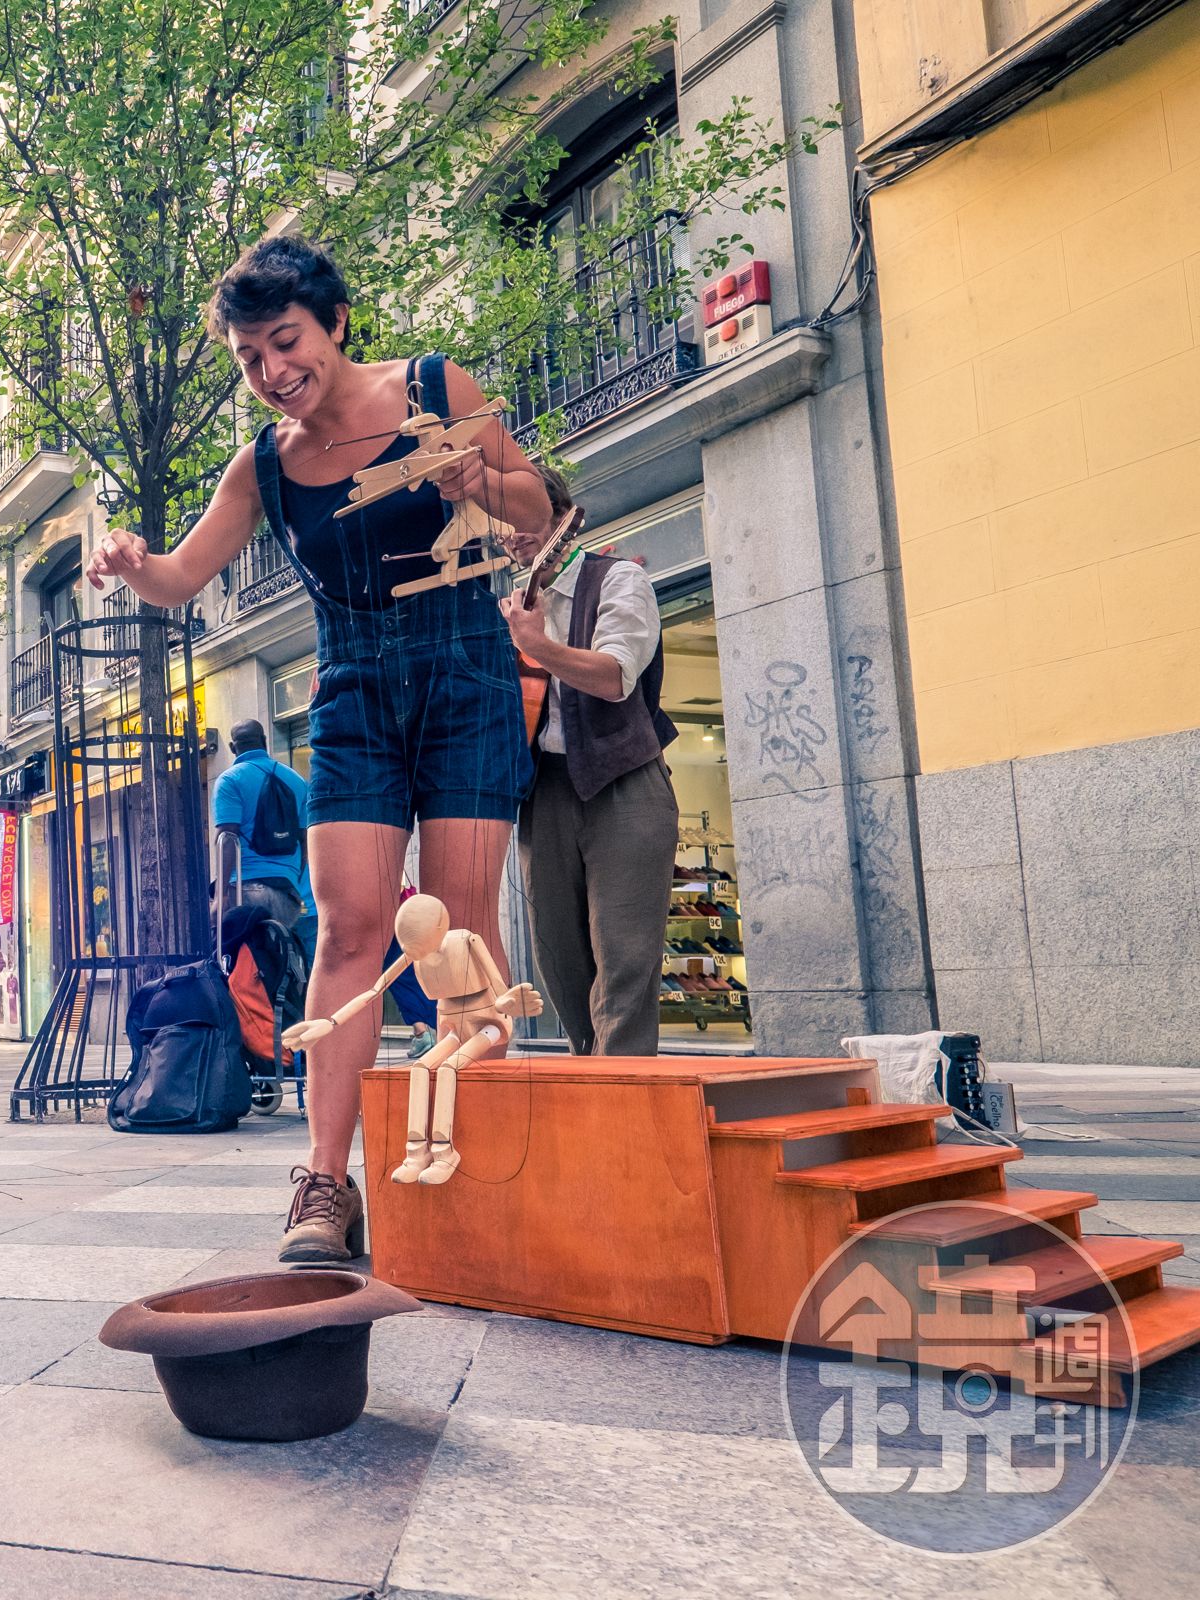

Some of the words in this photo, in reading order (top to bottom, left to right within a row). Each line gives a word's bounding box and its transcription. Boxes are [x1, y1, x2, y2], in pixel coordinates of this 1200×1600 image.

[714, 294, 745, 318] FUEGO
[709, 918, 720, 927] 9€
[730, 992, 739, 1002] 12€
[989, 1094, 1002, 1128] Coelho
